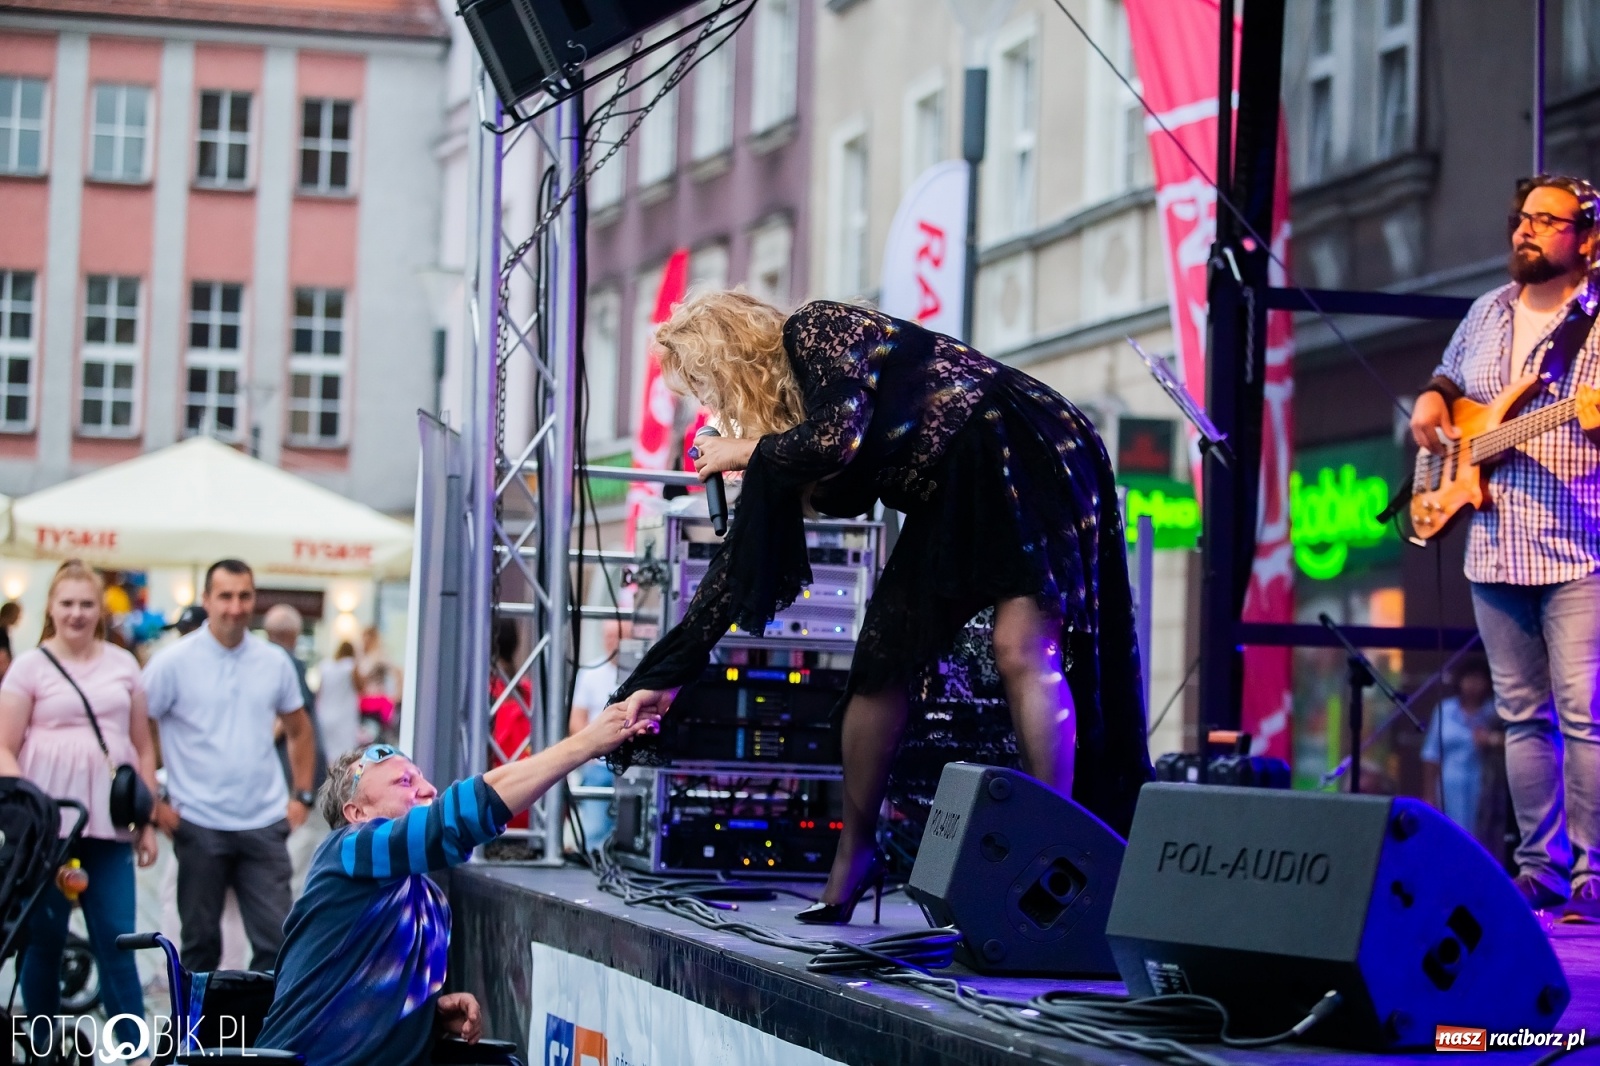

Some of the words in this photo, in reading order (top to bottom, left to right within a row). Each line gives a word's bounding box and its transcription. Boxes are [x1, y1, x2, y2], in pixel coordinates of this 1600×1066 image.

[36, 526, 118, 548] TYSKIE
[931, 808, 960, 840] POL-AUDIO
[1157, 841, 1331, 886] POL-AUDIO
